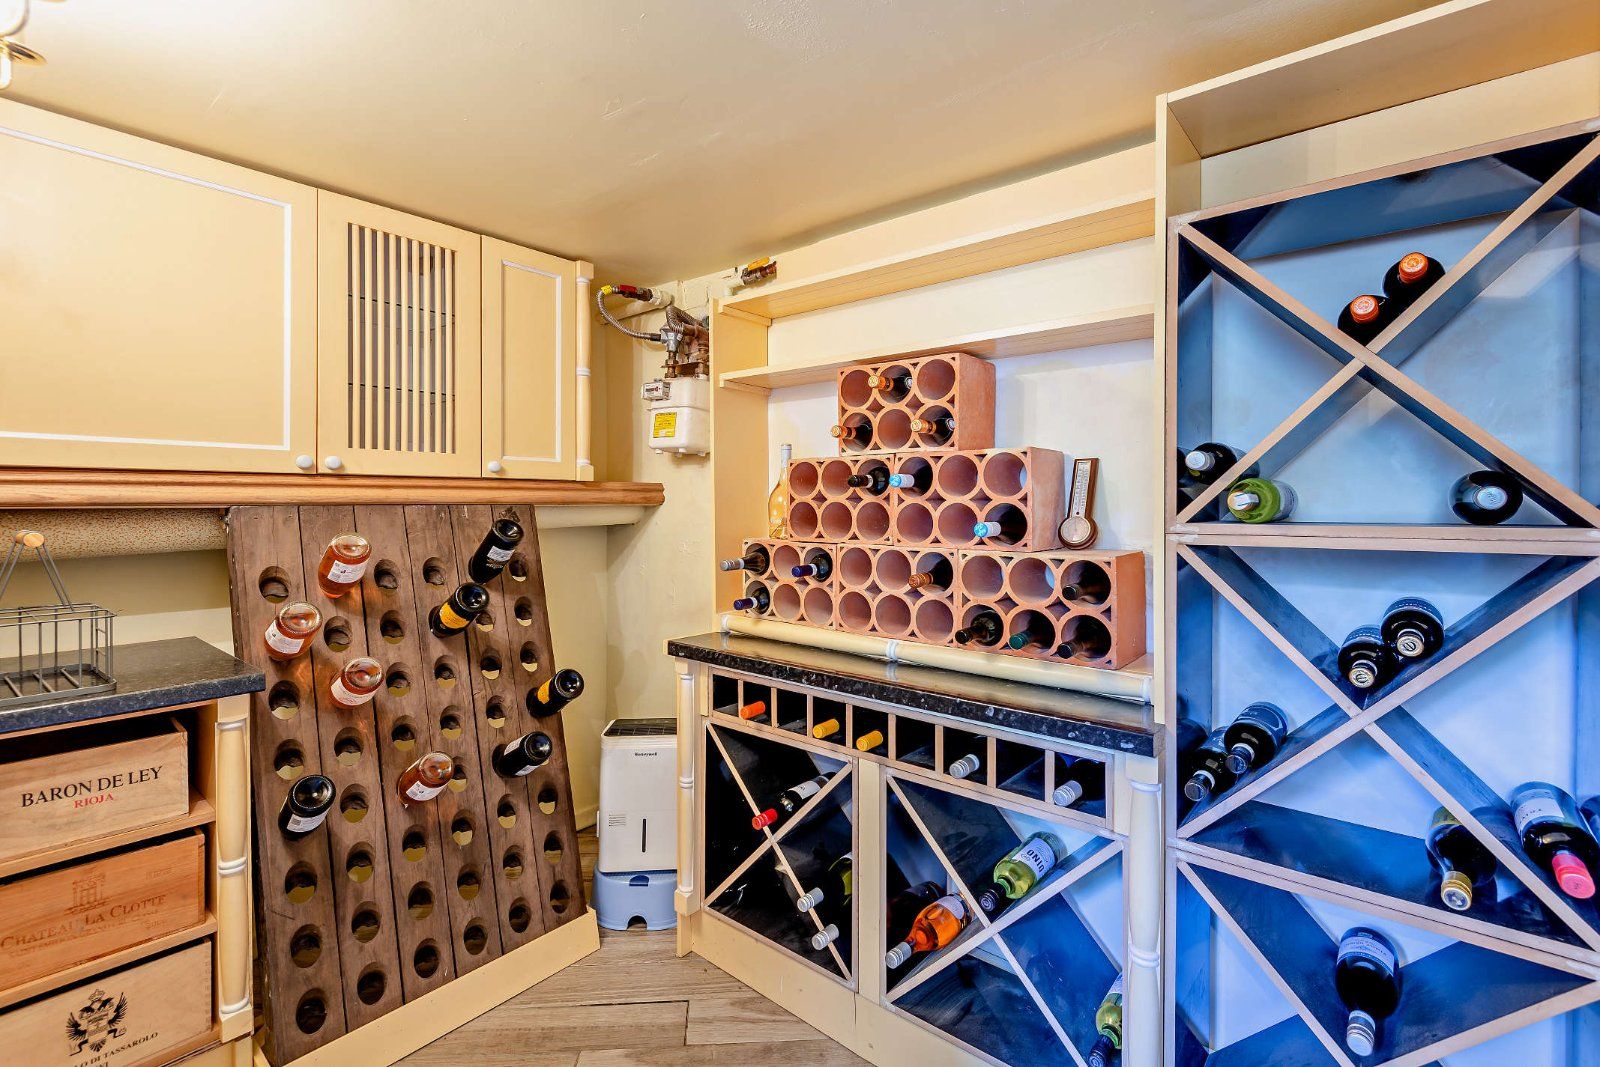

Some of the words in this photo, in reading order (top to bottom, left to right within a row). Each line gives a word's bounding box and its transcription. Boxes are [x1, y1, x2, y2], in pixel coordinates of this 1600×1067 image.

[21, 780, 92, 807] BARON
[98, 774, 124, 791] DE
[128, 766, 162, 785] LEY
[74, 792, 115, 809] RIOJA
[85, 913, 105, 926] LA
[104, 1032, 159, 1058] TASSAROLO
